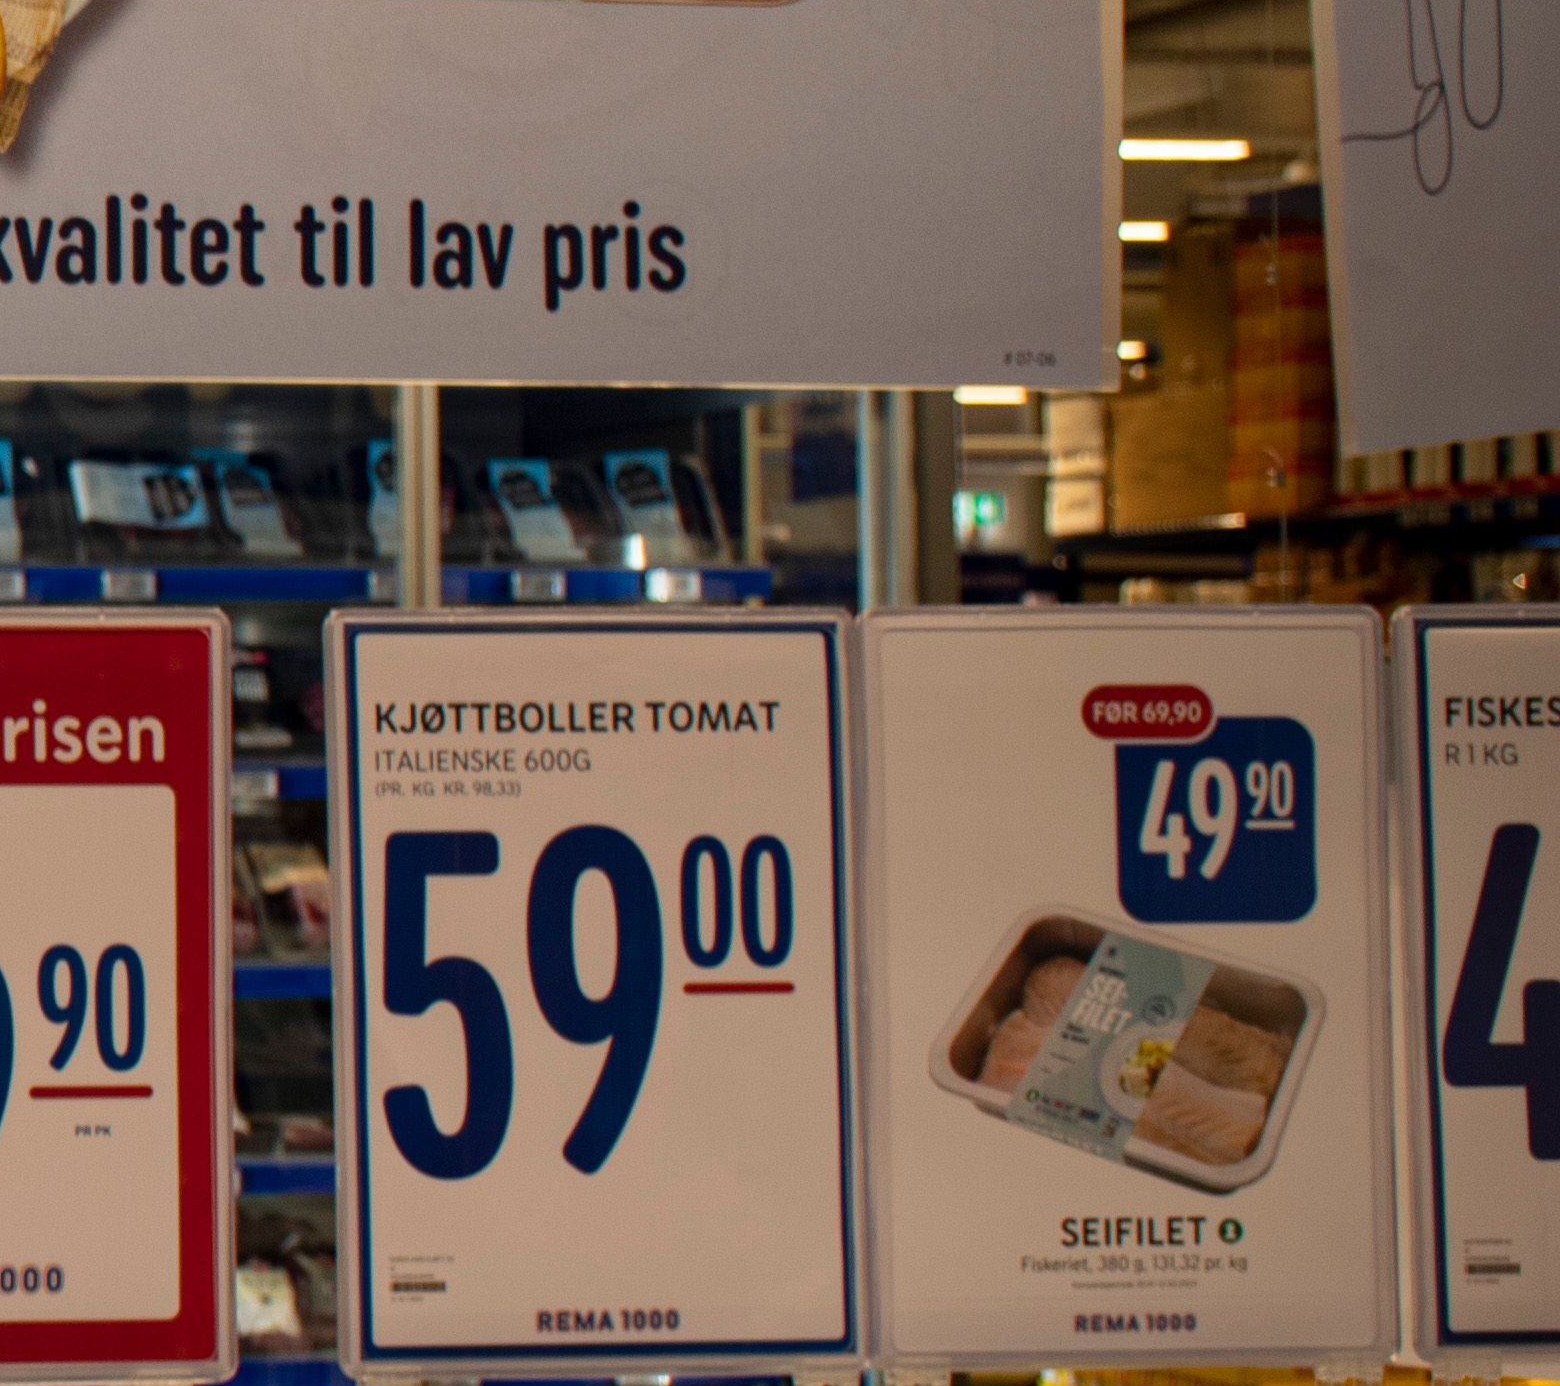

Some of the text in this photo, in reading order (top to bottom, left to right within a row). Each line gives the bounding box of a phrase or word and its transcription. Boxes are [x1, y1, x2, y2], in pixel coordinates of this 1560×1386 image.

[294, 196, 374, 287] til
[410, 199, 513, 289] lav
[544, 201, 686, 312] pris
[376, 702, 779, 733] KJØTTBOLLER TOMAT
[1093, 701, 1207, 731] FØR 69,90
[1446, 698, 1560, 728] FISKES
[375, 748, 591, 772] ITALIENSKE 600G
[1140, 758, 1294, 879] 49 90
[38, 944, 145, 1071] 90
[383, 824, 793, 1180] 59 00
[1062, 1216, 1206, 1247] SEIFILET
[537, 1309, 680, 1332] REMA 1000
[1075, 1314, 1197, 1332] REMA 1000
